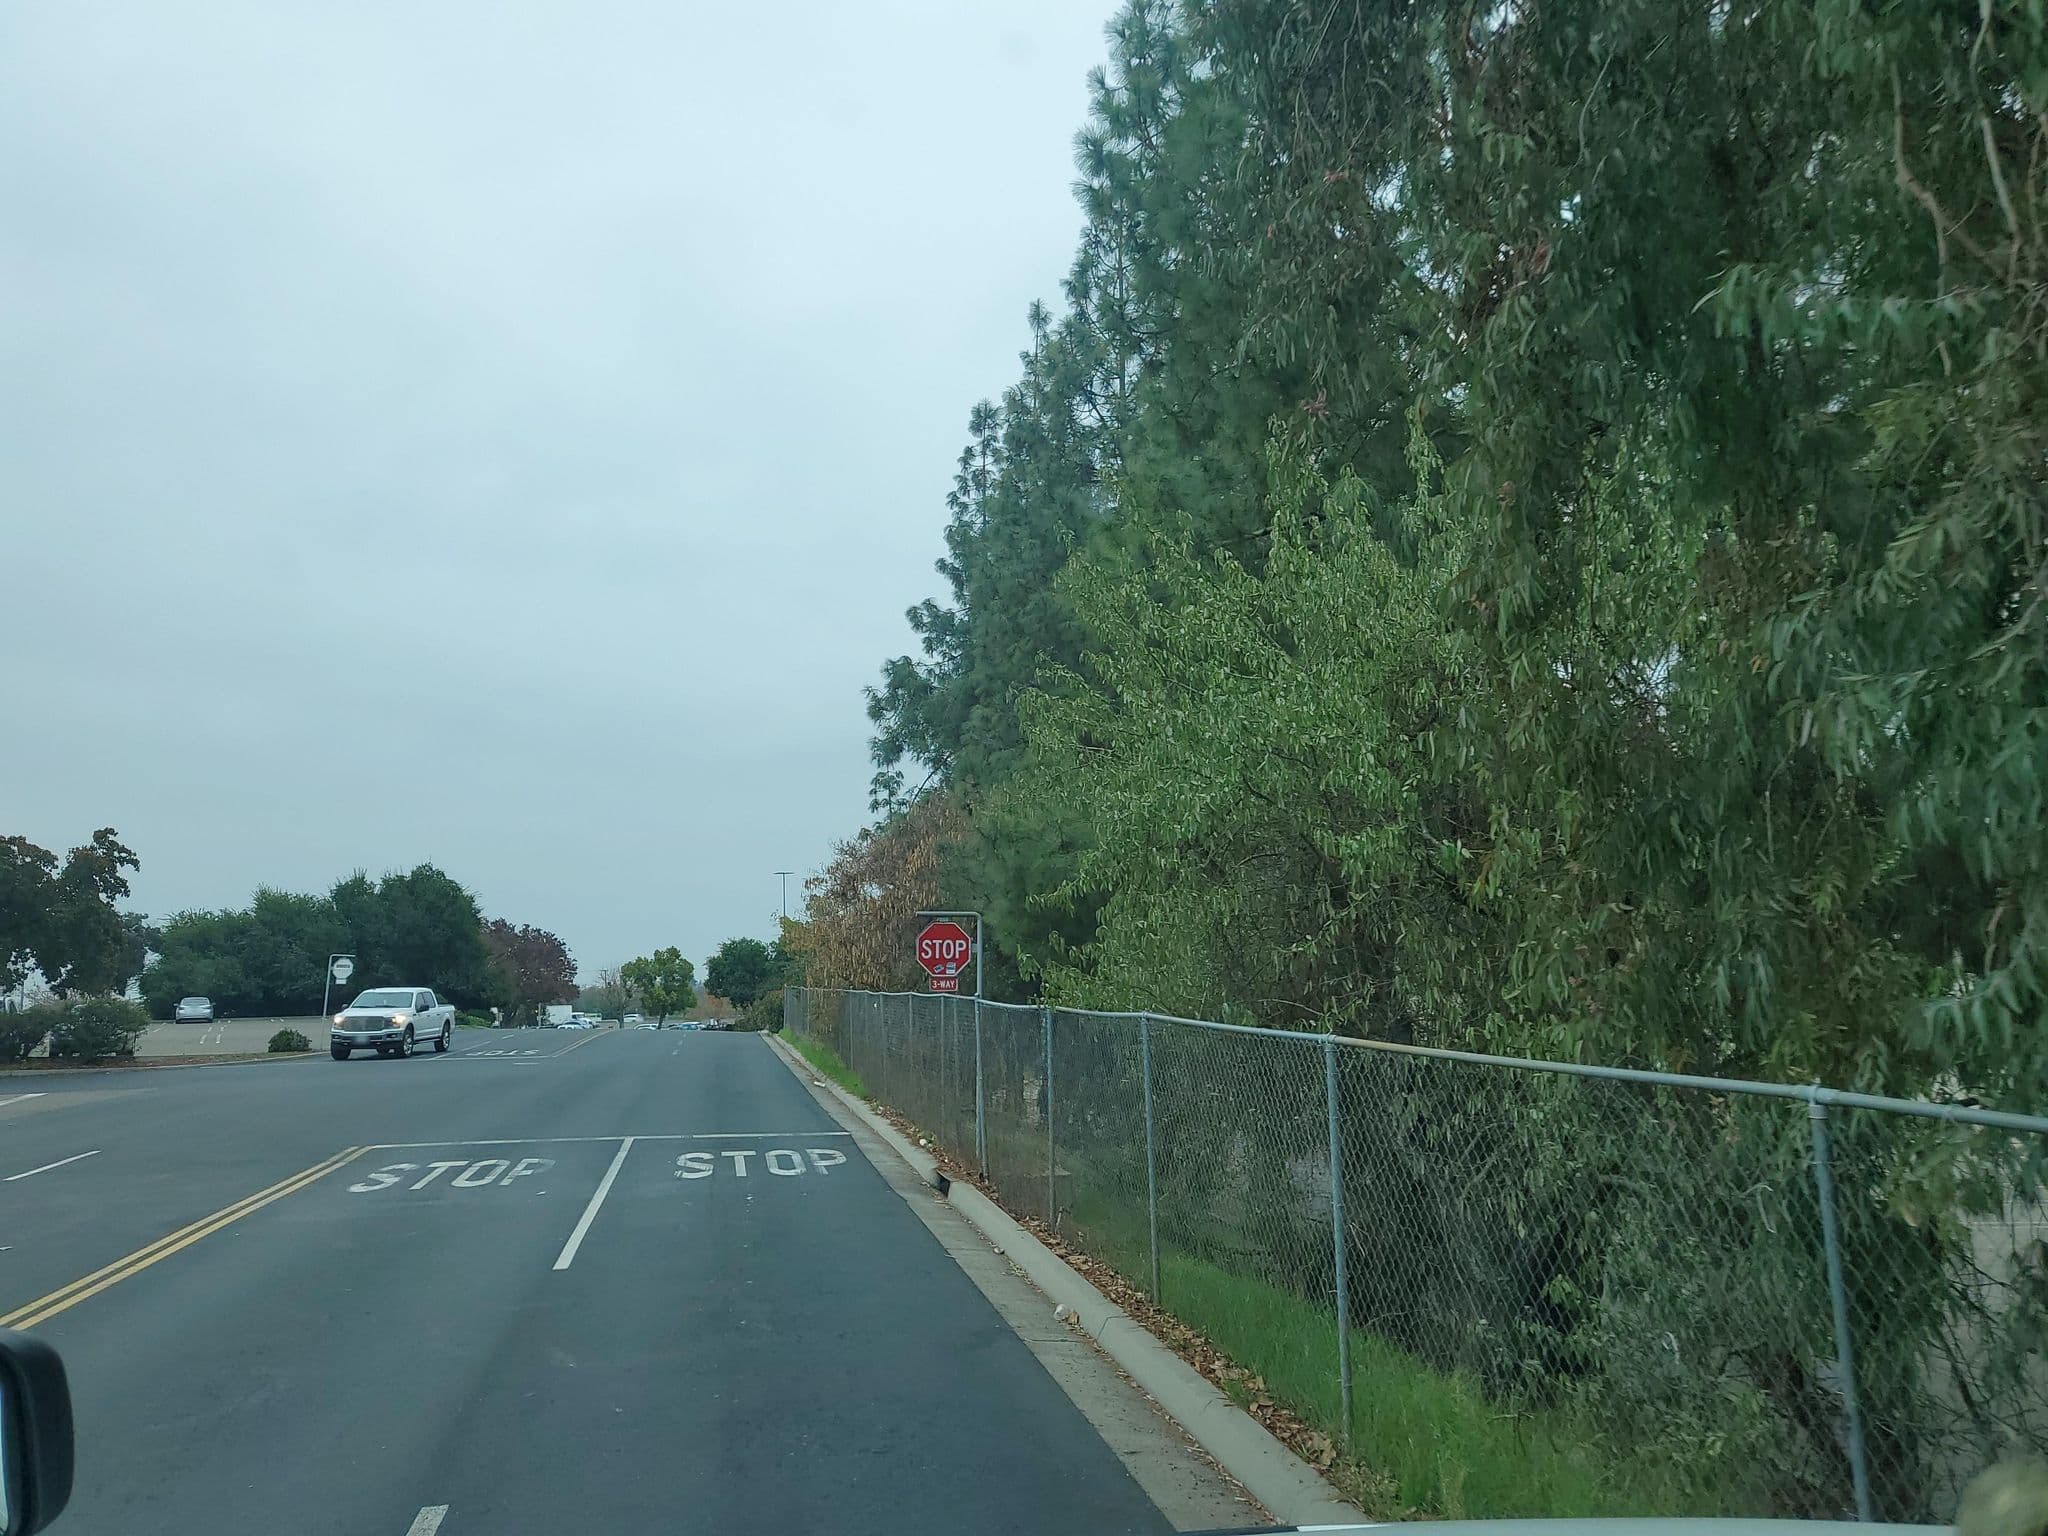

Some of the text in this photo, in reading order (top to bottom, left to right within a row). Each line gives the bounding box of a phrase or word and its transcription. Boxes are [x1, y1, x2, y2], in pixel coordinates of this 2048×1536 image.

[921, 939, 967, 959] STOP
[932, 980, 955, 989] 3-WAY
[347, 1158, 555, 1193] STOP
[674, 1148, 847, 1179] STOP
